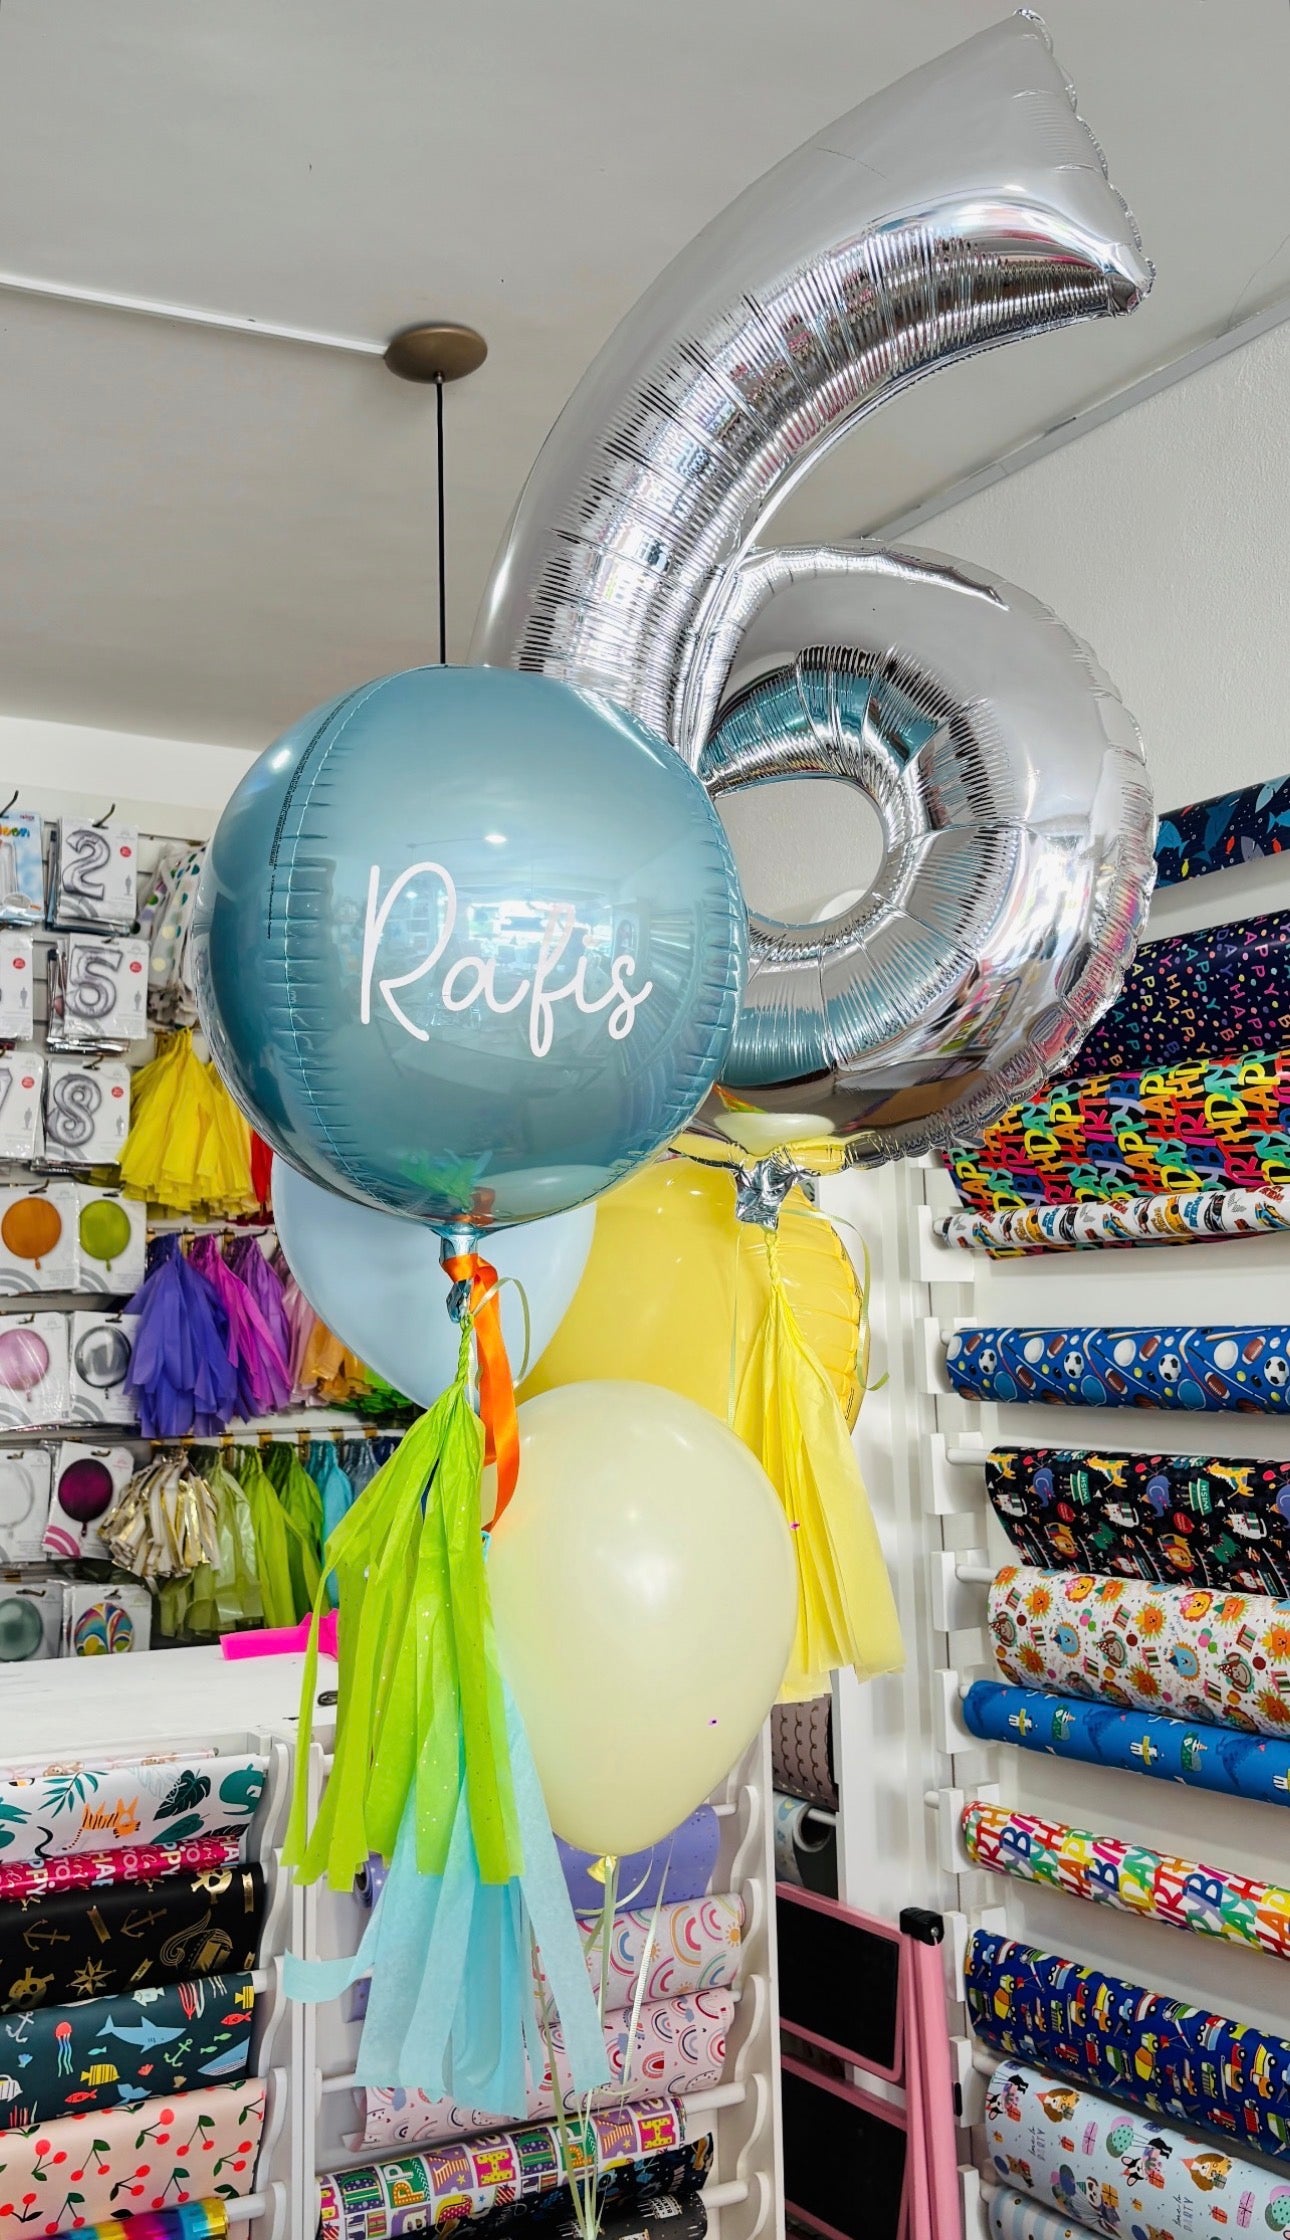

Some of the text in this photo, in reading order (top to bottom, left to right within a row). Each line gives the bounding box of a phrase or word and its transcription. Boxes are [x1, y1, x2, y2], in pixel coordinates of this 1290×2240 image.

[360, 861, 653, 1058] Rafis
[1131, 944, 1167, 1025] HAPPY
[1166, 973, 1211, 1054] HAPPY
